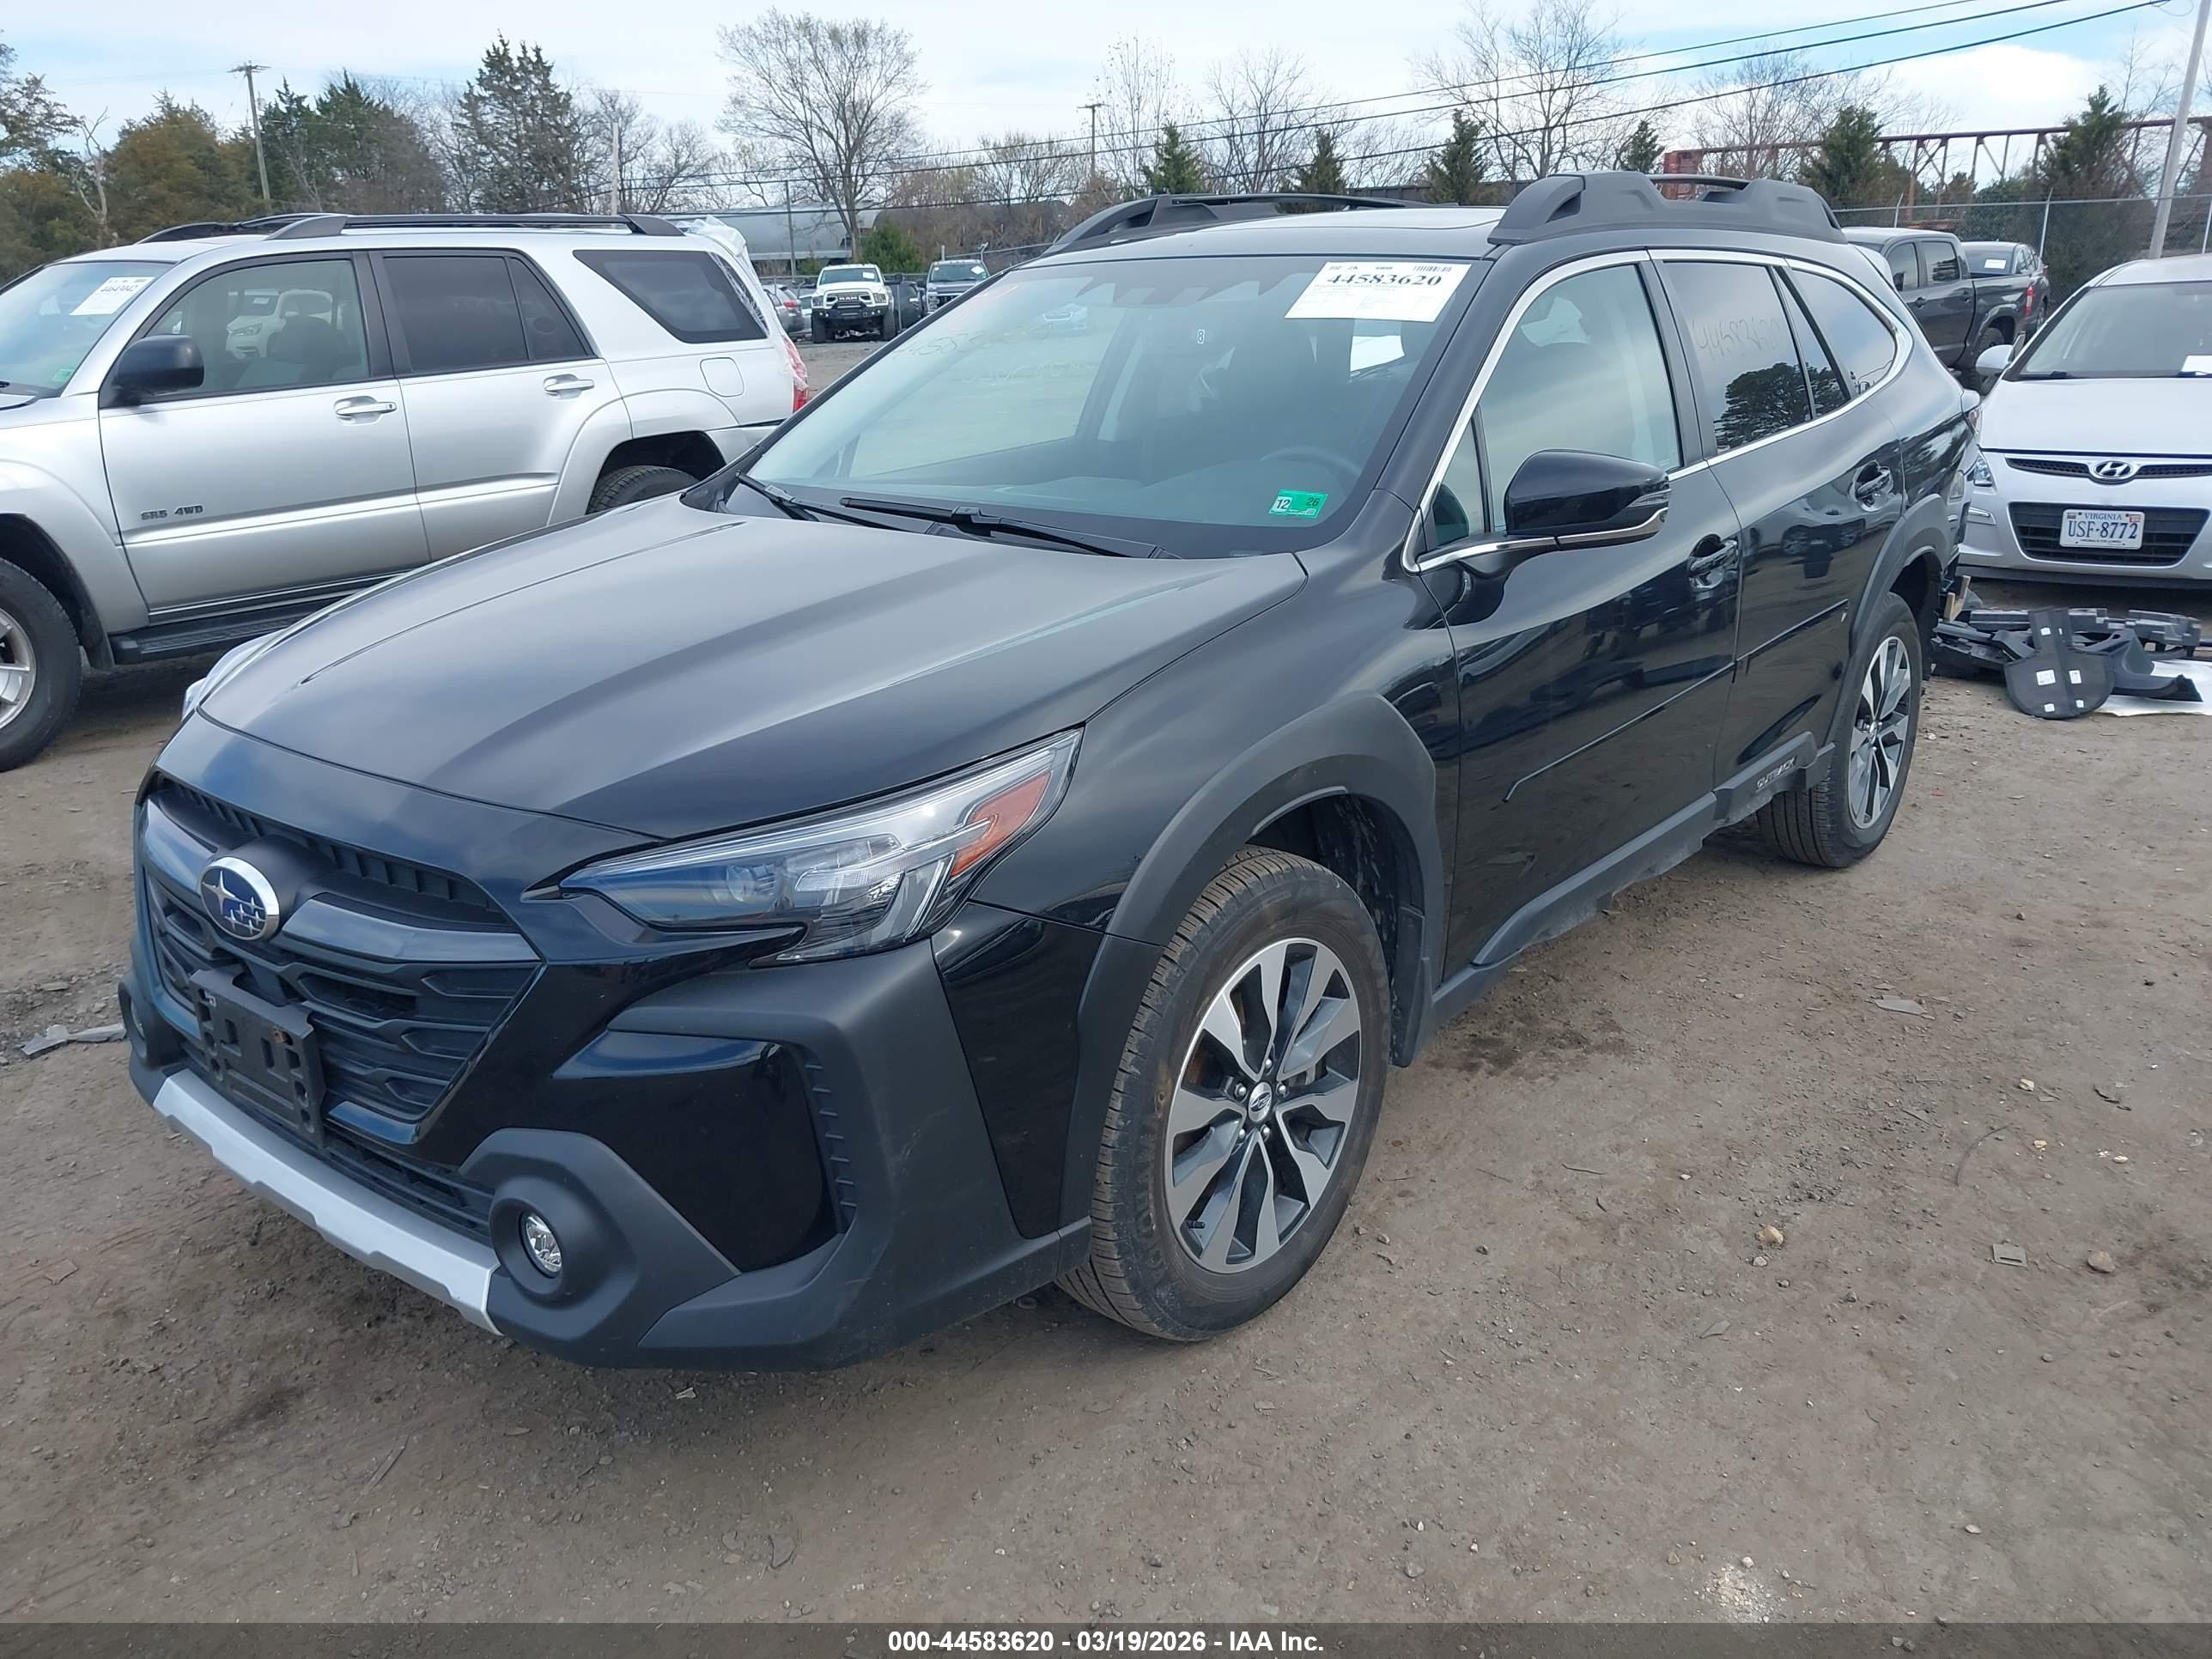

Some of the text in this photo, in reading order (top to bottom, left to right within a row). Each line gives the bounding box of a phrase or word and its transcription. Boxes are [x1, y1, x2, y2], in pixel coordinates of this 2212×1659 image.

[1327, 274, 1442, 286] 44583620
[1276, 496, 1321, 510] 12 26
[140, 505, 204, 520] SR5 4WD
[2084, 512, 2123, 521] VIRGINIA
[2067, 520, 2139, 540] USF-8772
